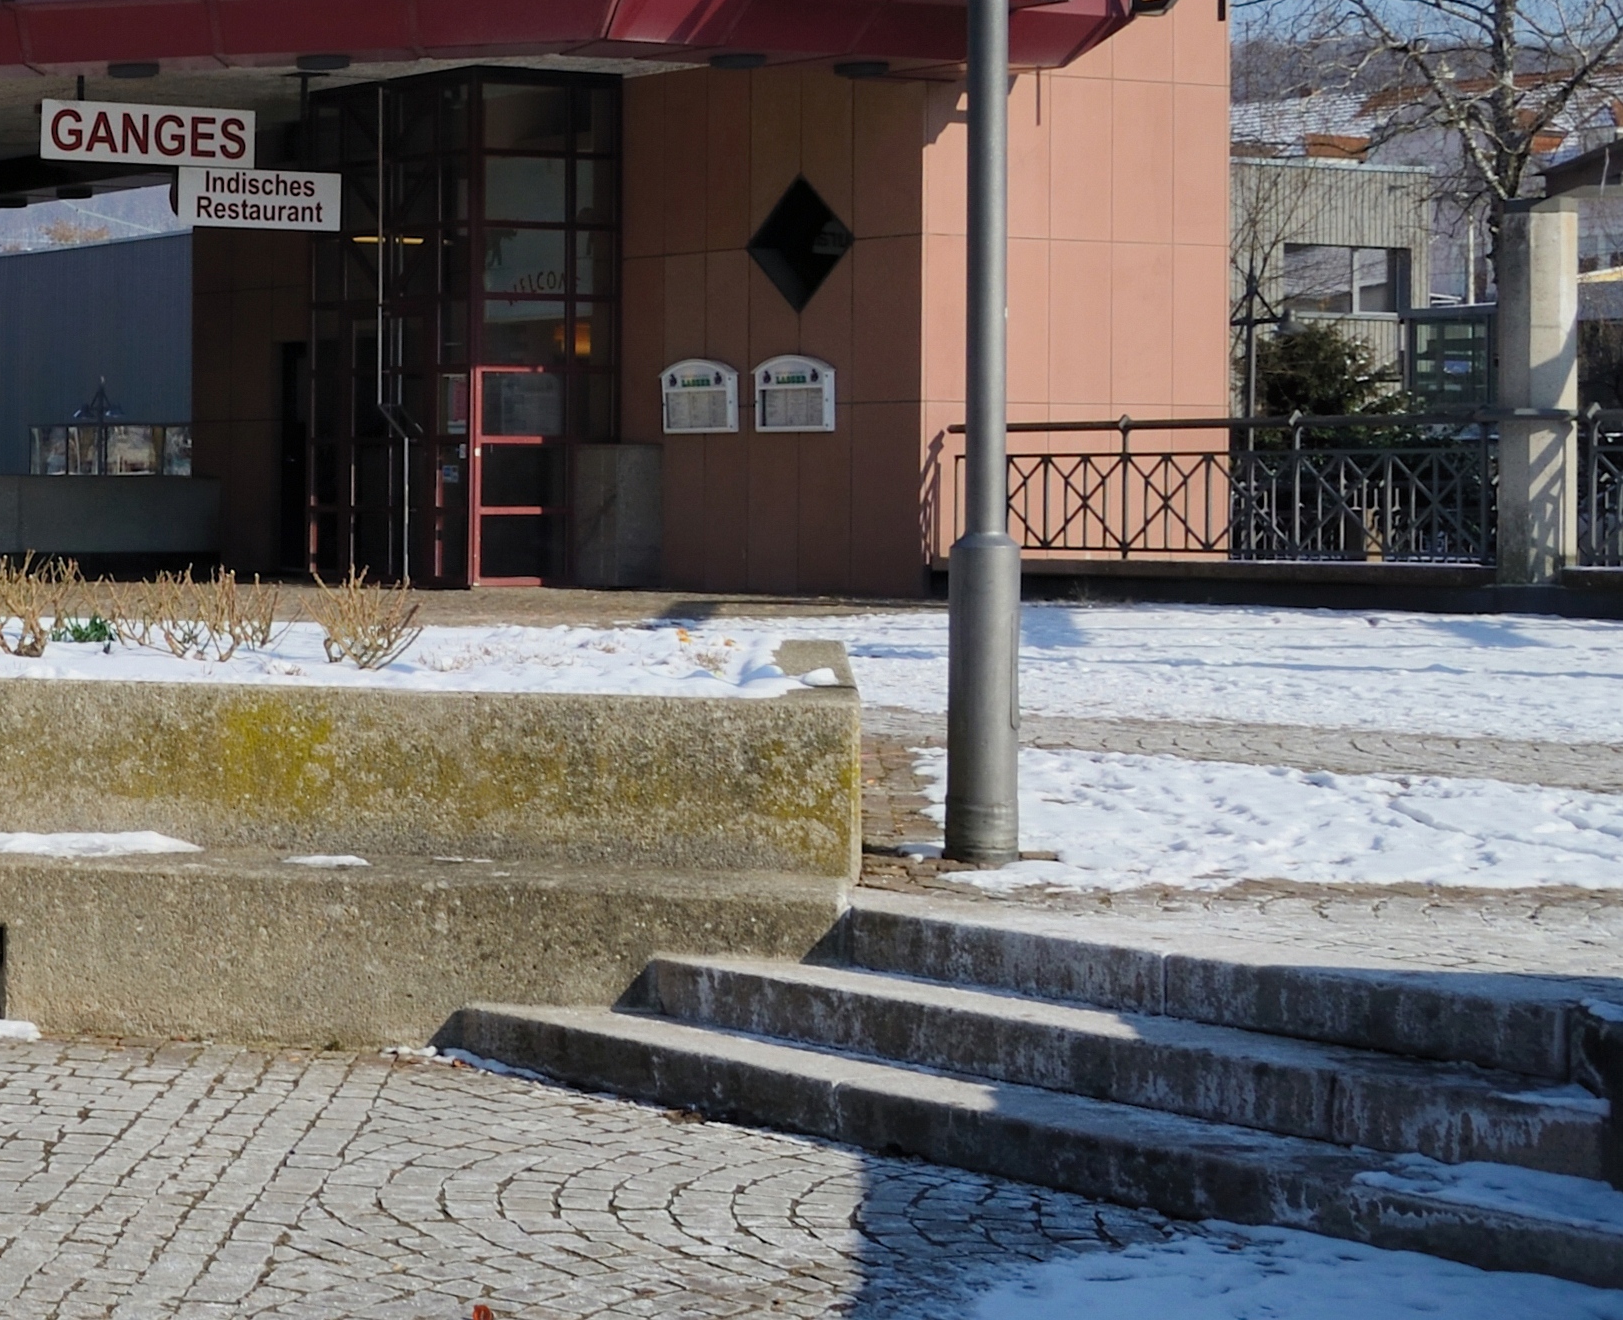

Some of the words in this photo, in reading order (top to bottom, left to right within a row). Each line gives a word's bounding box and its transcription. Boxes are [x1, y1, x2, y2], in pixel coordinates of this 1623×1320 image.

[50, 108, 247, 159] GANGES
[205, 170, 316, 198] Indisches
[196, 195, 323, 223] Restaurant
